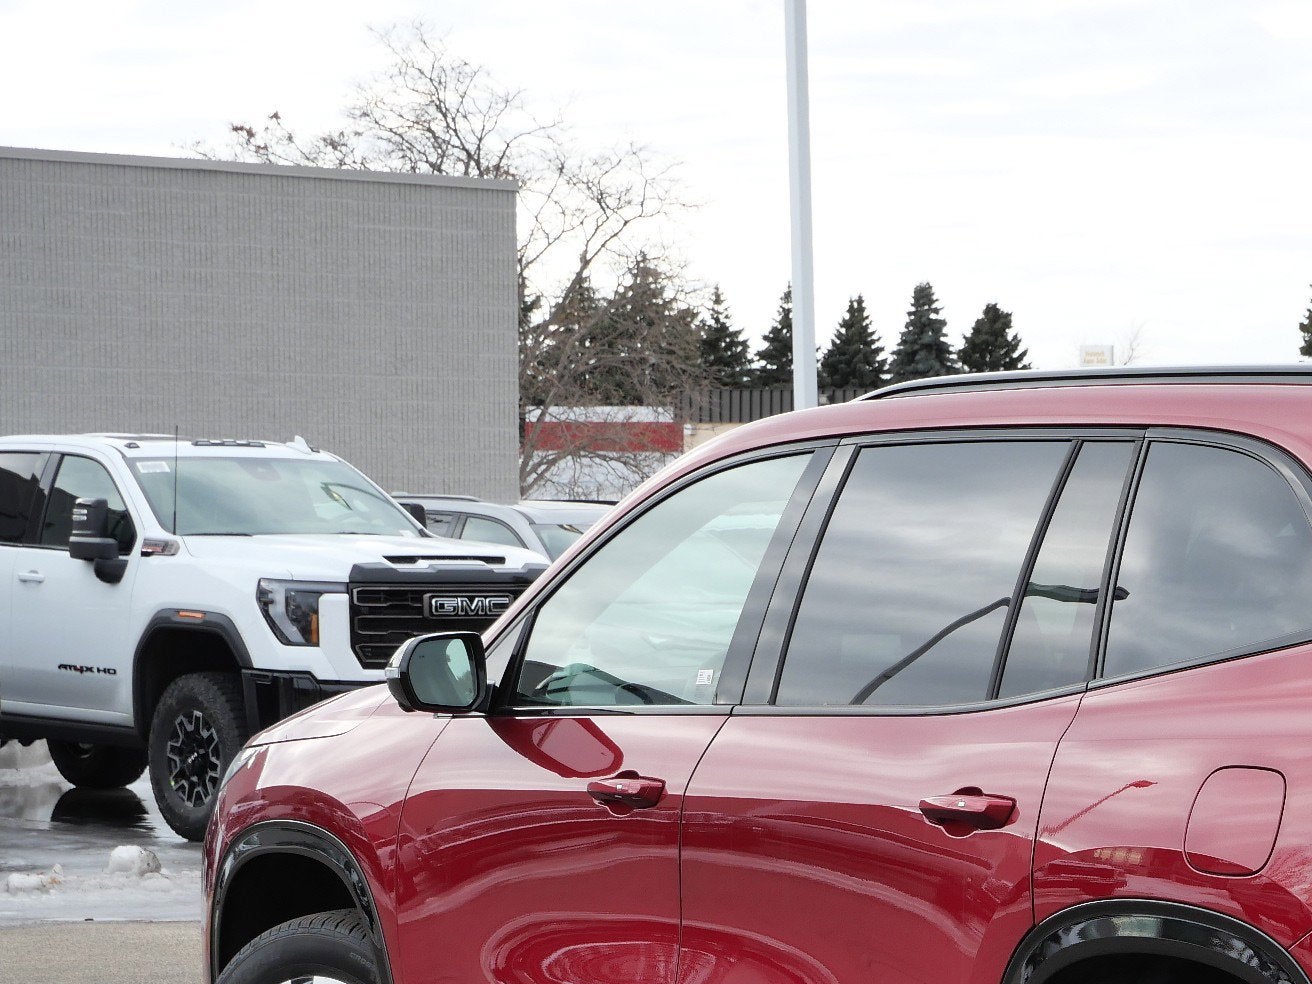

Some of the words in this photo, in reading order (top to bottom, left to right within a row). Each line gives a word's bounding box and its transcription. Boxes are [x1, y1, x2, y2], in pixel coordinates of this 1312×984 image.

[432, 597, 510, 615] GMC
[58, 663, 95, 674] AT4X
[97, 667, 117, 675] HD
